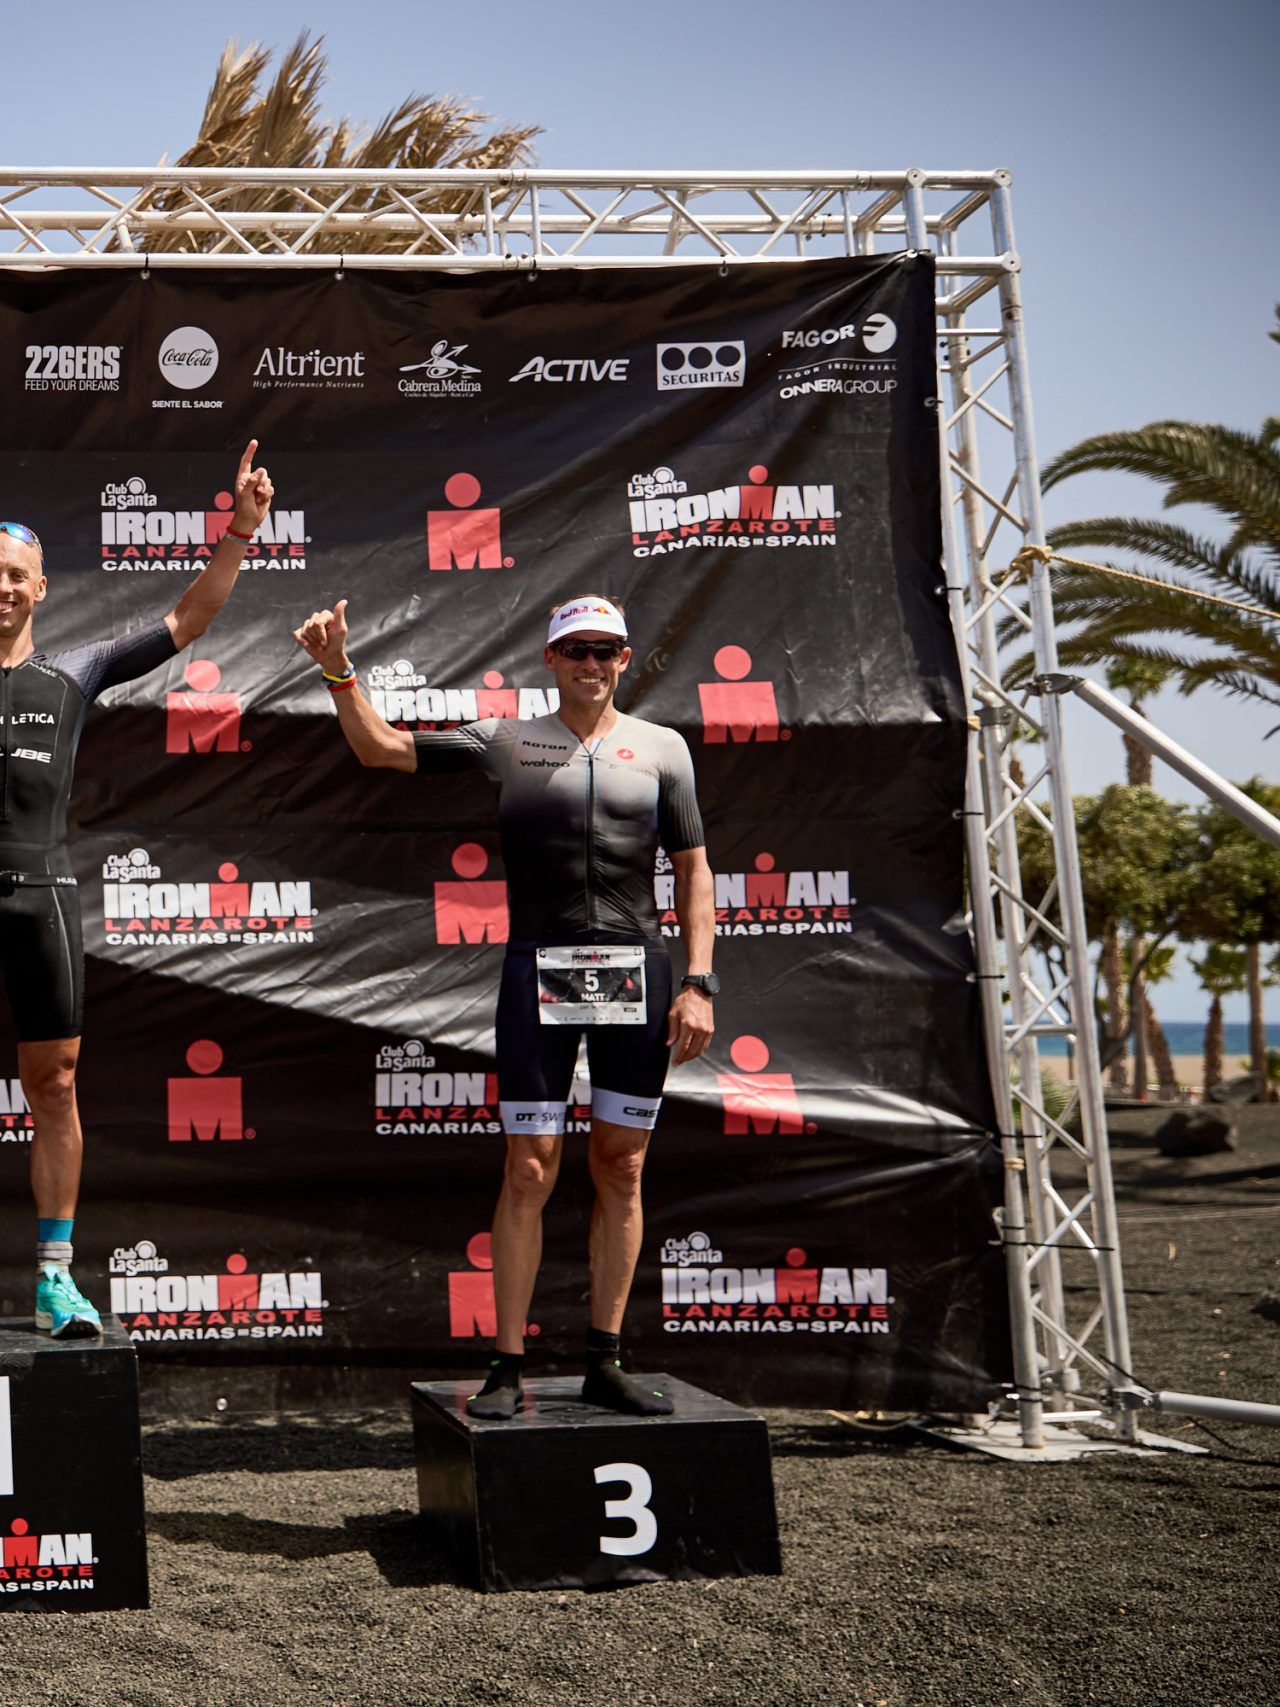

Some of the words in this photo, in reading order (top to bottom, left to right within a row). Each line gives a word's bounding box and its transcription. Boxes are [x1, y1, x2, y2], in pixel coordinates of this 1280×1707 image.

[782, 324, 855, 348] FAGOR
[26, 345, 120, 379] 226ERS
[509, 356, 630, 381] ACTIVE
[828, 363, 897, 371] INDUSTRIAL
[253, 381, 271, 389] High
[663, 371, 740, 386] SECURITAS
[25, 380, 48, 390] FEED
[50, 380, 77, 390] YOUR
[79, 380, 119, 391] DREAMS
[398, 379, 440, 392] Cabrera
[441, 379, 481, 392] Medina
[632, 474, 654, 485] Club
[106, 484, 127, 495] Club
[629, 485, 834, 533] IRONMAN
[632, 520, 835, 545] LANZAROTE
[634, 534, 750, 558] CANARIAS
[765, 534, 836, 547] SPAIN
[372, 666, 394, 676] Club
[523, 740, 567, 750] ROTOR
[520, 759, 569, 768] wahoo
[108, 855, 130, 867] Club
[103, 881, 311, 918] IRONMAN
[105, 917, 312, 931] LANZAROTE
[779, 922, 852, 935] SPAIN
[106, 932, 230, 945] CANARIAS
[243, 931, 314, 944] SPAIN
[585, 970, 599, 992] 5
[581, 993, 605, 1002] MATT
[381, 1046, 404, 1057] Club
[516, 1113, 536, 1121] DT
[376, 1123, 501, 1135] CANARIAS
[665, 1239, 688, 1250] Club
[114, 1248, 136, 1259] Club
[110, 1272, 321, 1313] IRONMAN
[662, 1268, 887, 1304] IRONMAN
[663, 1305, 888, 1318] LANZAROTE
[251, 1325, 323, 1338] SPAIN
[664, 1320, 794, 1333] CANARIAS
[811, 1321, 889, 1334] SPAIN
[594, 1463, 657, 1556] 3
[32, 1579, 94, 1592] SPAIN
